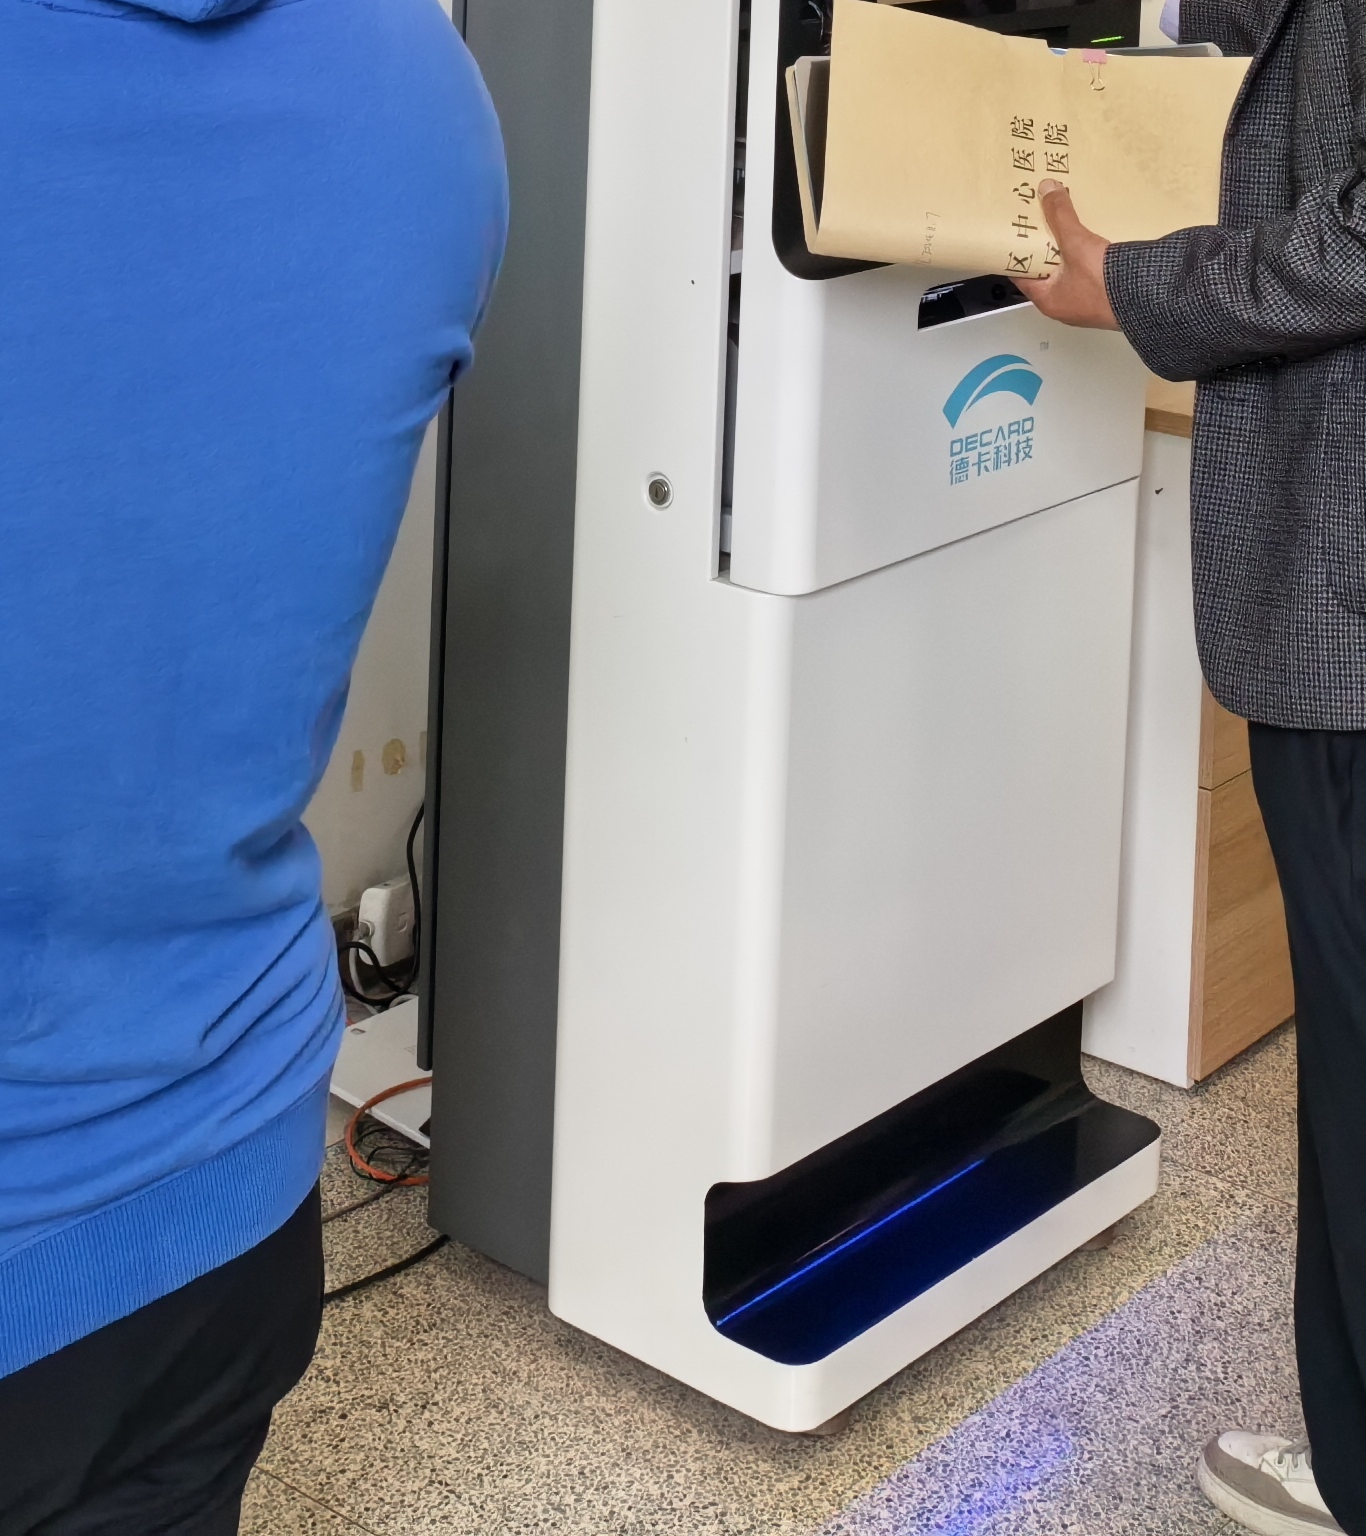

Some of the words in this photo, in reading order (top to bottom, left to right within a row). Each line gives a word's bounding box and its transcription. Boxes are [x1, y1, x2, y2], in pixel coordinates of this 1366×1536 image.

[1005, 115, 1038, 273] 区中心医院
[949, 416, 1035, 458] DECARD
[949, 436, 1034, 486] 德卡科技
